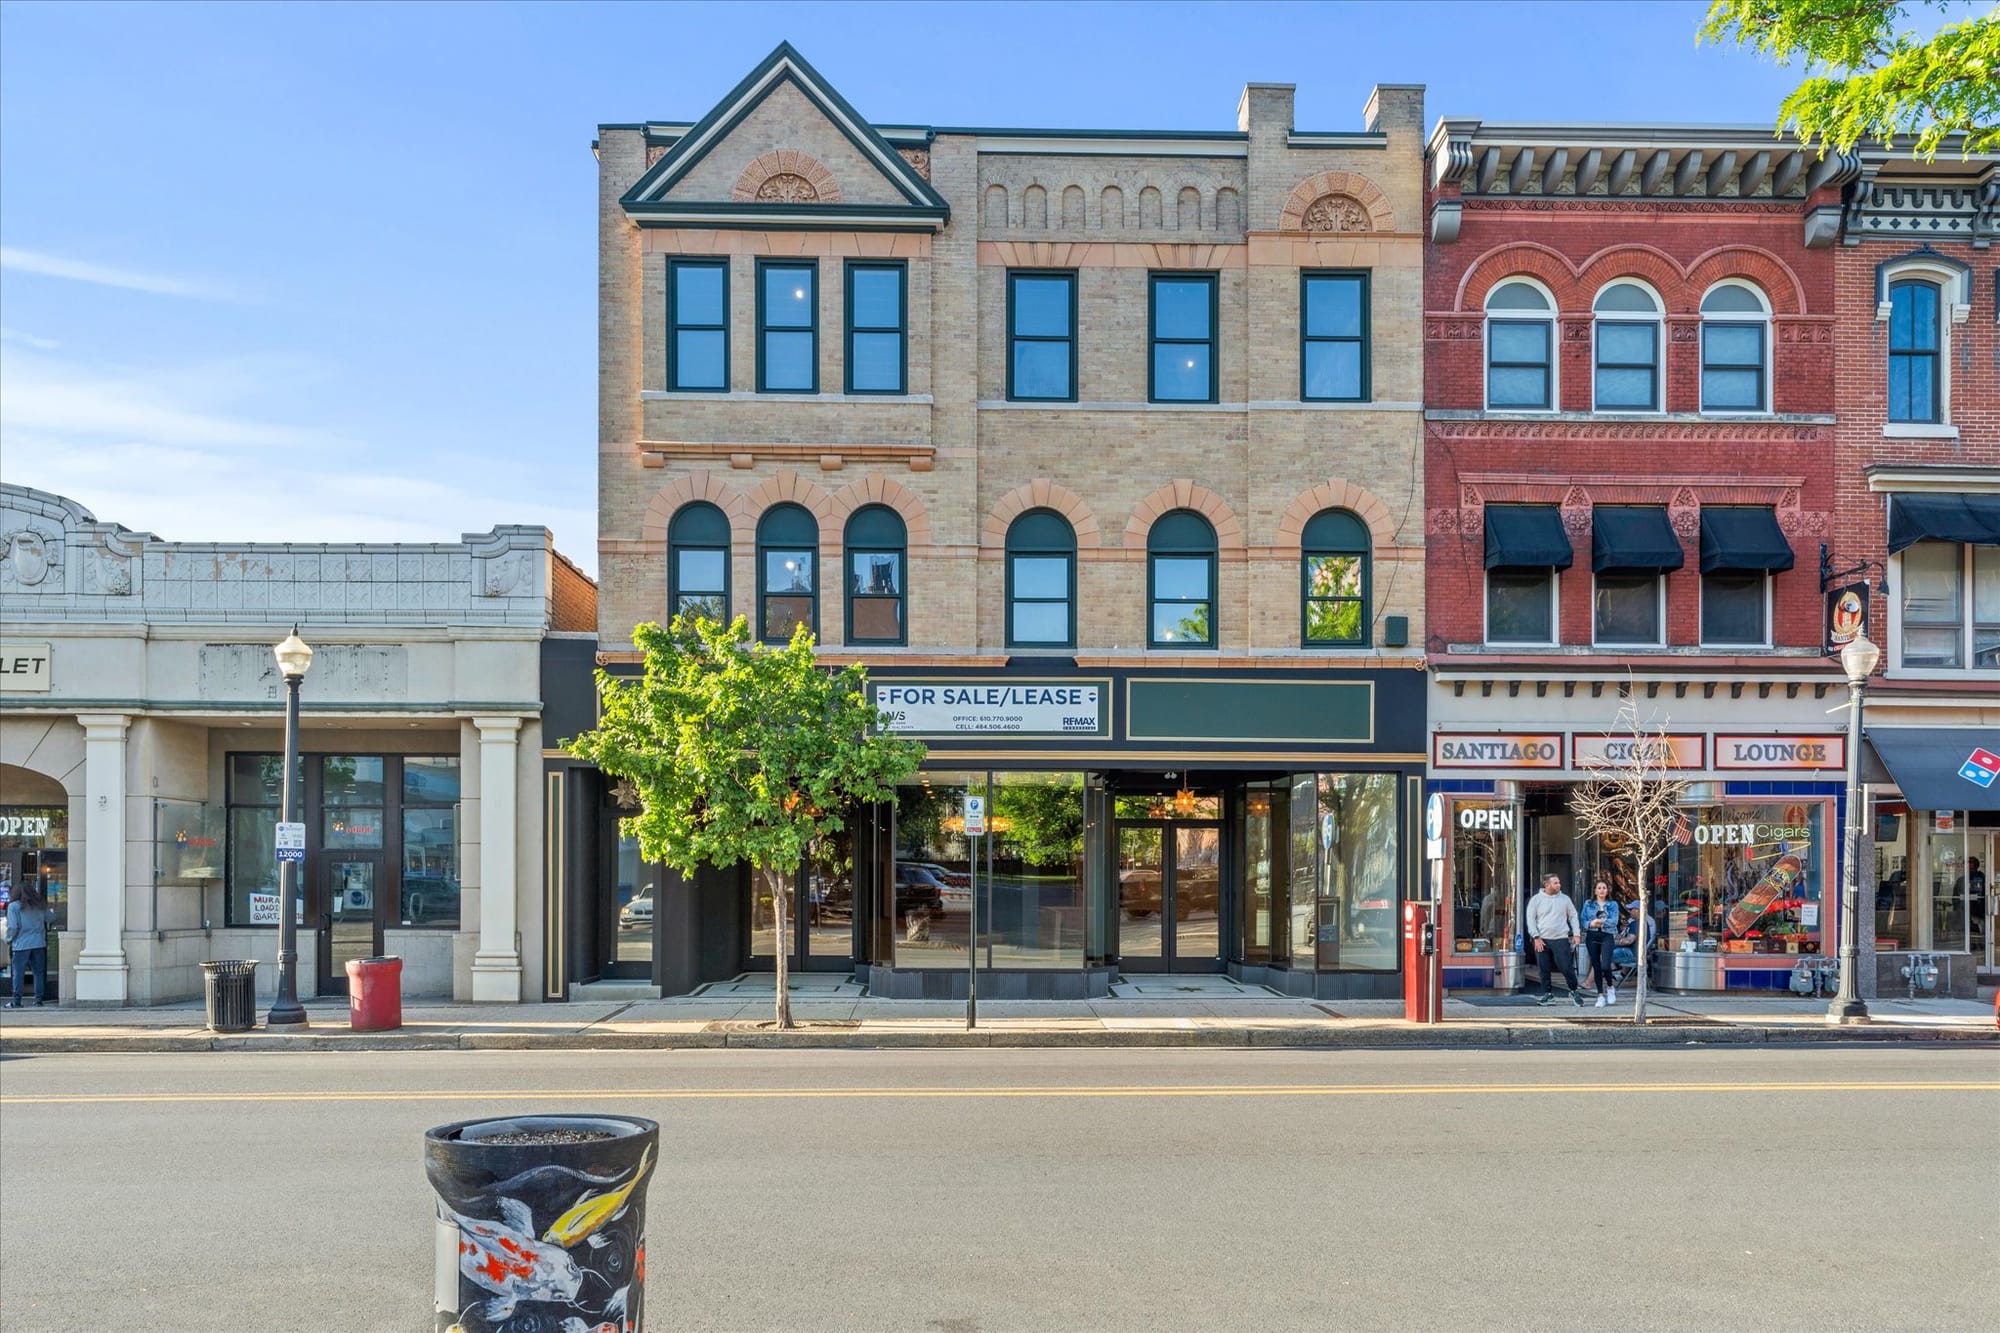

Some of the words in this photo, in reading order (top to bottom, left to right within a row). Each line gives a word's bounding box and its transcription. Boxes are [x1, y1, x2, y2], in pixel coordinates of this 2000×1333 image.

[890, 688, 935, 705] FOR
[943, 686, 1082, 708] SALE/LEASE
[1441, 742, 1556, 761] SANTIAGO
[1733, 743, 1827, 762] LOUNGE
[1460, 809, 1513, 830] OPEN
[1694, 824, 1755, 846] OPEN
[1755, 824, 1811, 840] Cigars
[279, 850, 303, 858] 12000
[253, 896, 281, 904] MURA
